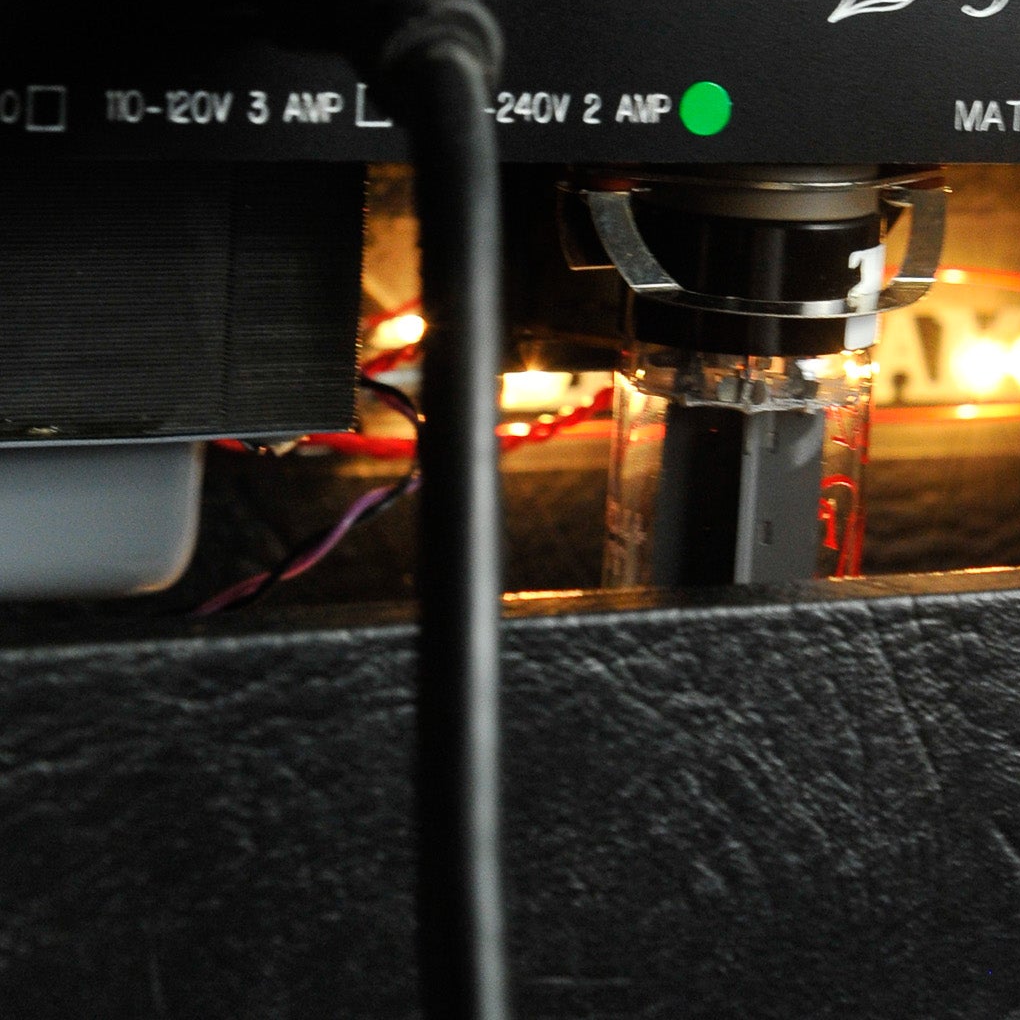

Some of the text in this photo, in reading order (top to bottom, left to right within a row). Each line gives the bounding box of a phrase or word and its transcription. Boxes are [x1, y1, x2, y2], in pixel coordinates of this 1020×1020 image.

[105, 89, 345, 125] 110-120V 3 AMP
[484, 91, 674, 126] -240V 2 AMP
